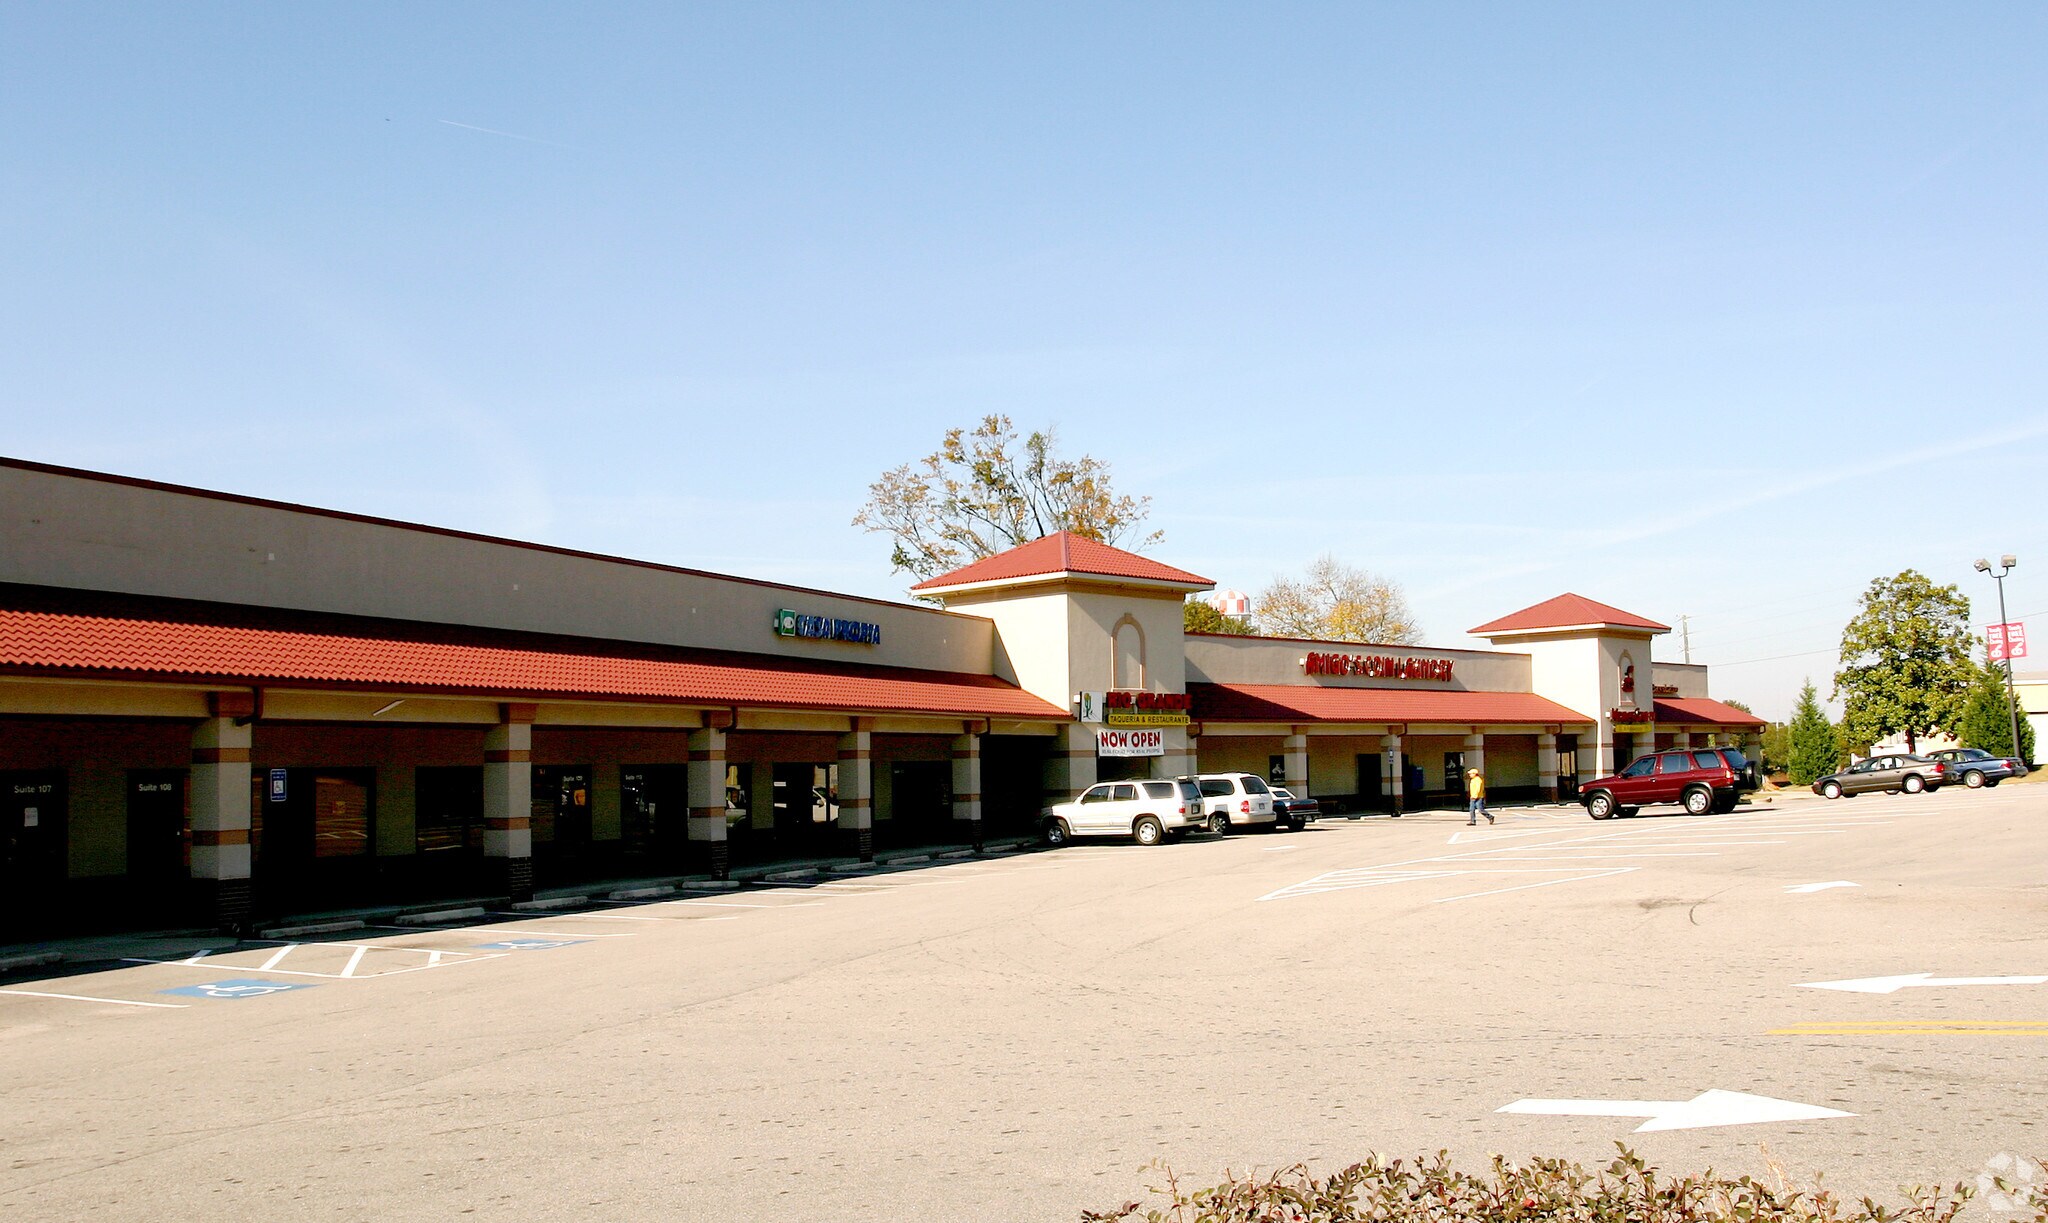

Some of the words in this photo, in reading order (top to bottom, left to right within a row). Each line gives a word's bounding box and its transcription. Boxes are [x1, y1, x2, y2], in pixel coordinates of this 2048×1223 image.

[797, 615, 831, 639] CASA
[833, 619, 881, 644] PROPIA
[1364, 655, 1394, 678] COIN
[1106, 691, 1131, 709] RIO
[1137, 693, 1192, 710] GRANDE
[1110, 716, 1140, 724] TAQUERIA
[1148, 715, 1189, 723] RESTAURANTE
[1101, 732, 1128, 747] NOW
[1131, 732, 1160, 747] OPEN
[14, 784, 35, 794] Suite
[39, 784, 52, 794] 107
[138, 783, 157, 792] Suite
